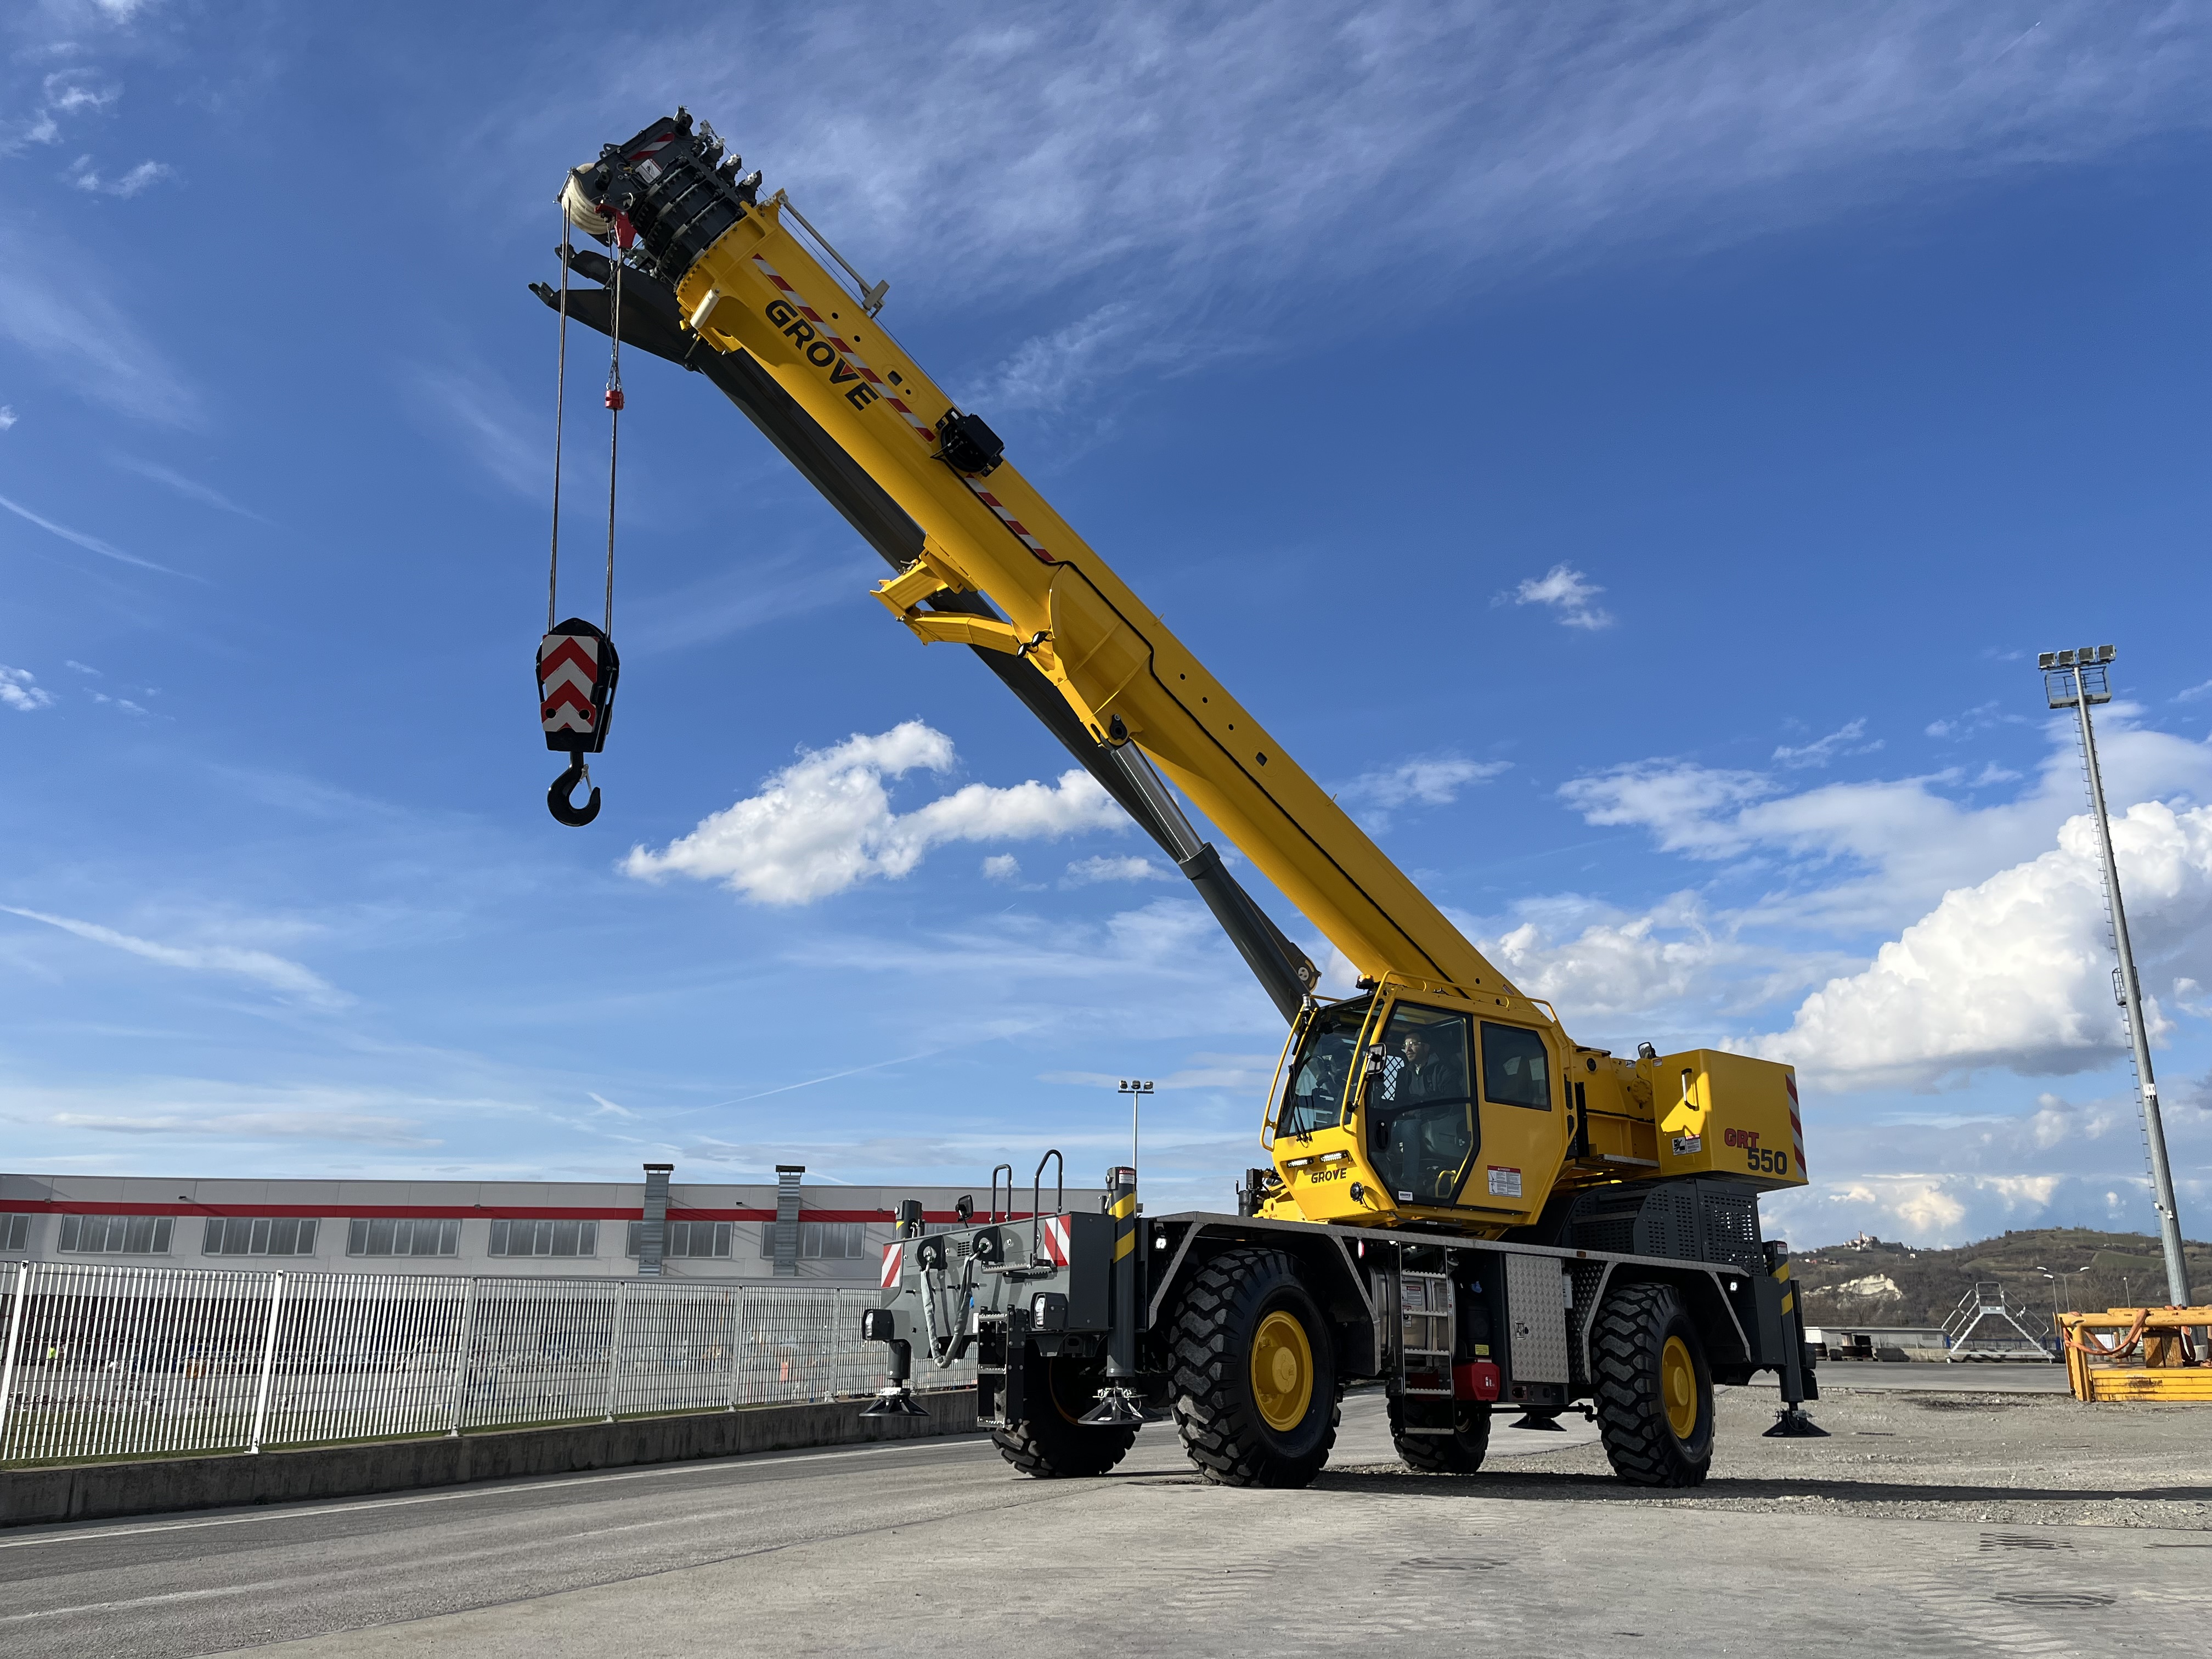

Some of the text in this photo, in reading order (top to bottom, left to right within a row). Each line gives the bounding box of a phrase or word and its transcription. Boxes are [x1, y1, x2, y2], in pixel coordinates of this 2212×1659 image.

[765, 300, 879, 411] GROVE
[1724, 1128, 1759, 1149] GRT
[1747, 1147, 1787, 1175] 550
[1311, 1168, 1347, 1183] GROVE
